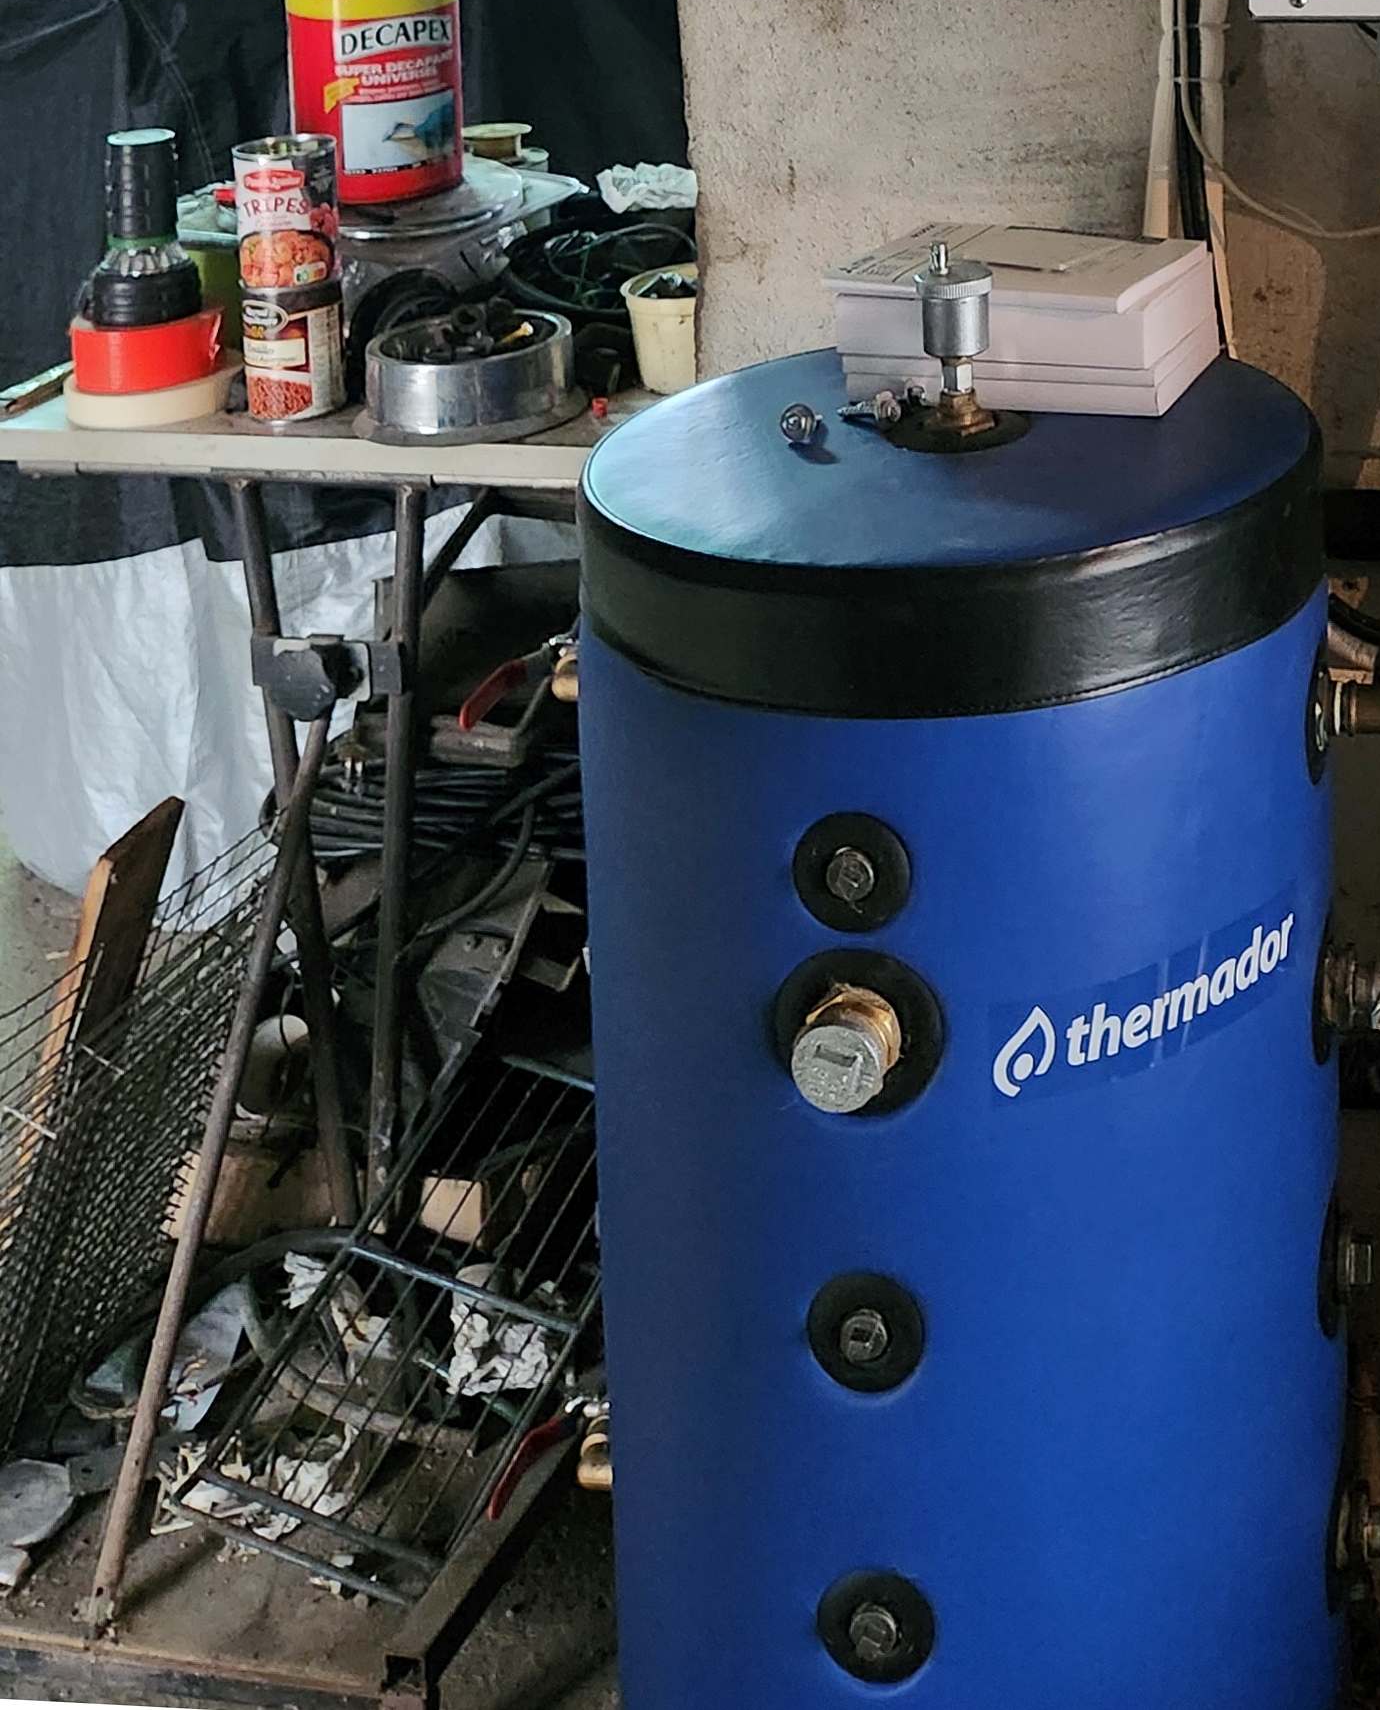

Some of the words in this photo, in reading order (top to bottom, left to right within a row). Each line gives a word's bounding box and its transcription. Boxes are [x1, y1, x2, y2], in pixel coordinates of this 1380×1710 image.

[340, 18, 451, 57] DECAPEX
[334, 63, 383, 78] SUPER
[242, 197, 311, 218] TRIPES
[1066, 912, 1295, 1067] thermador
